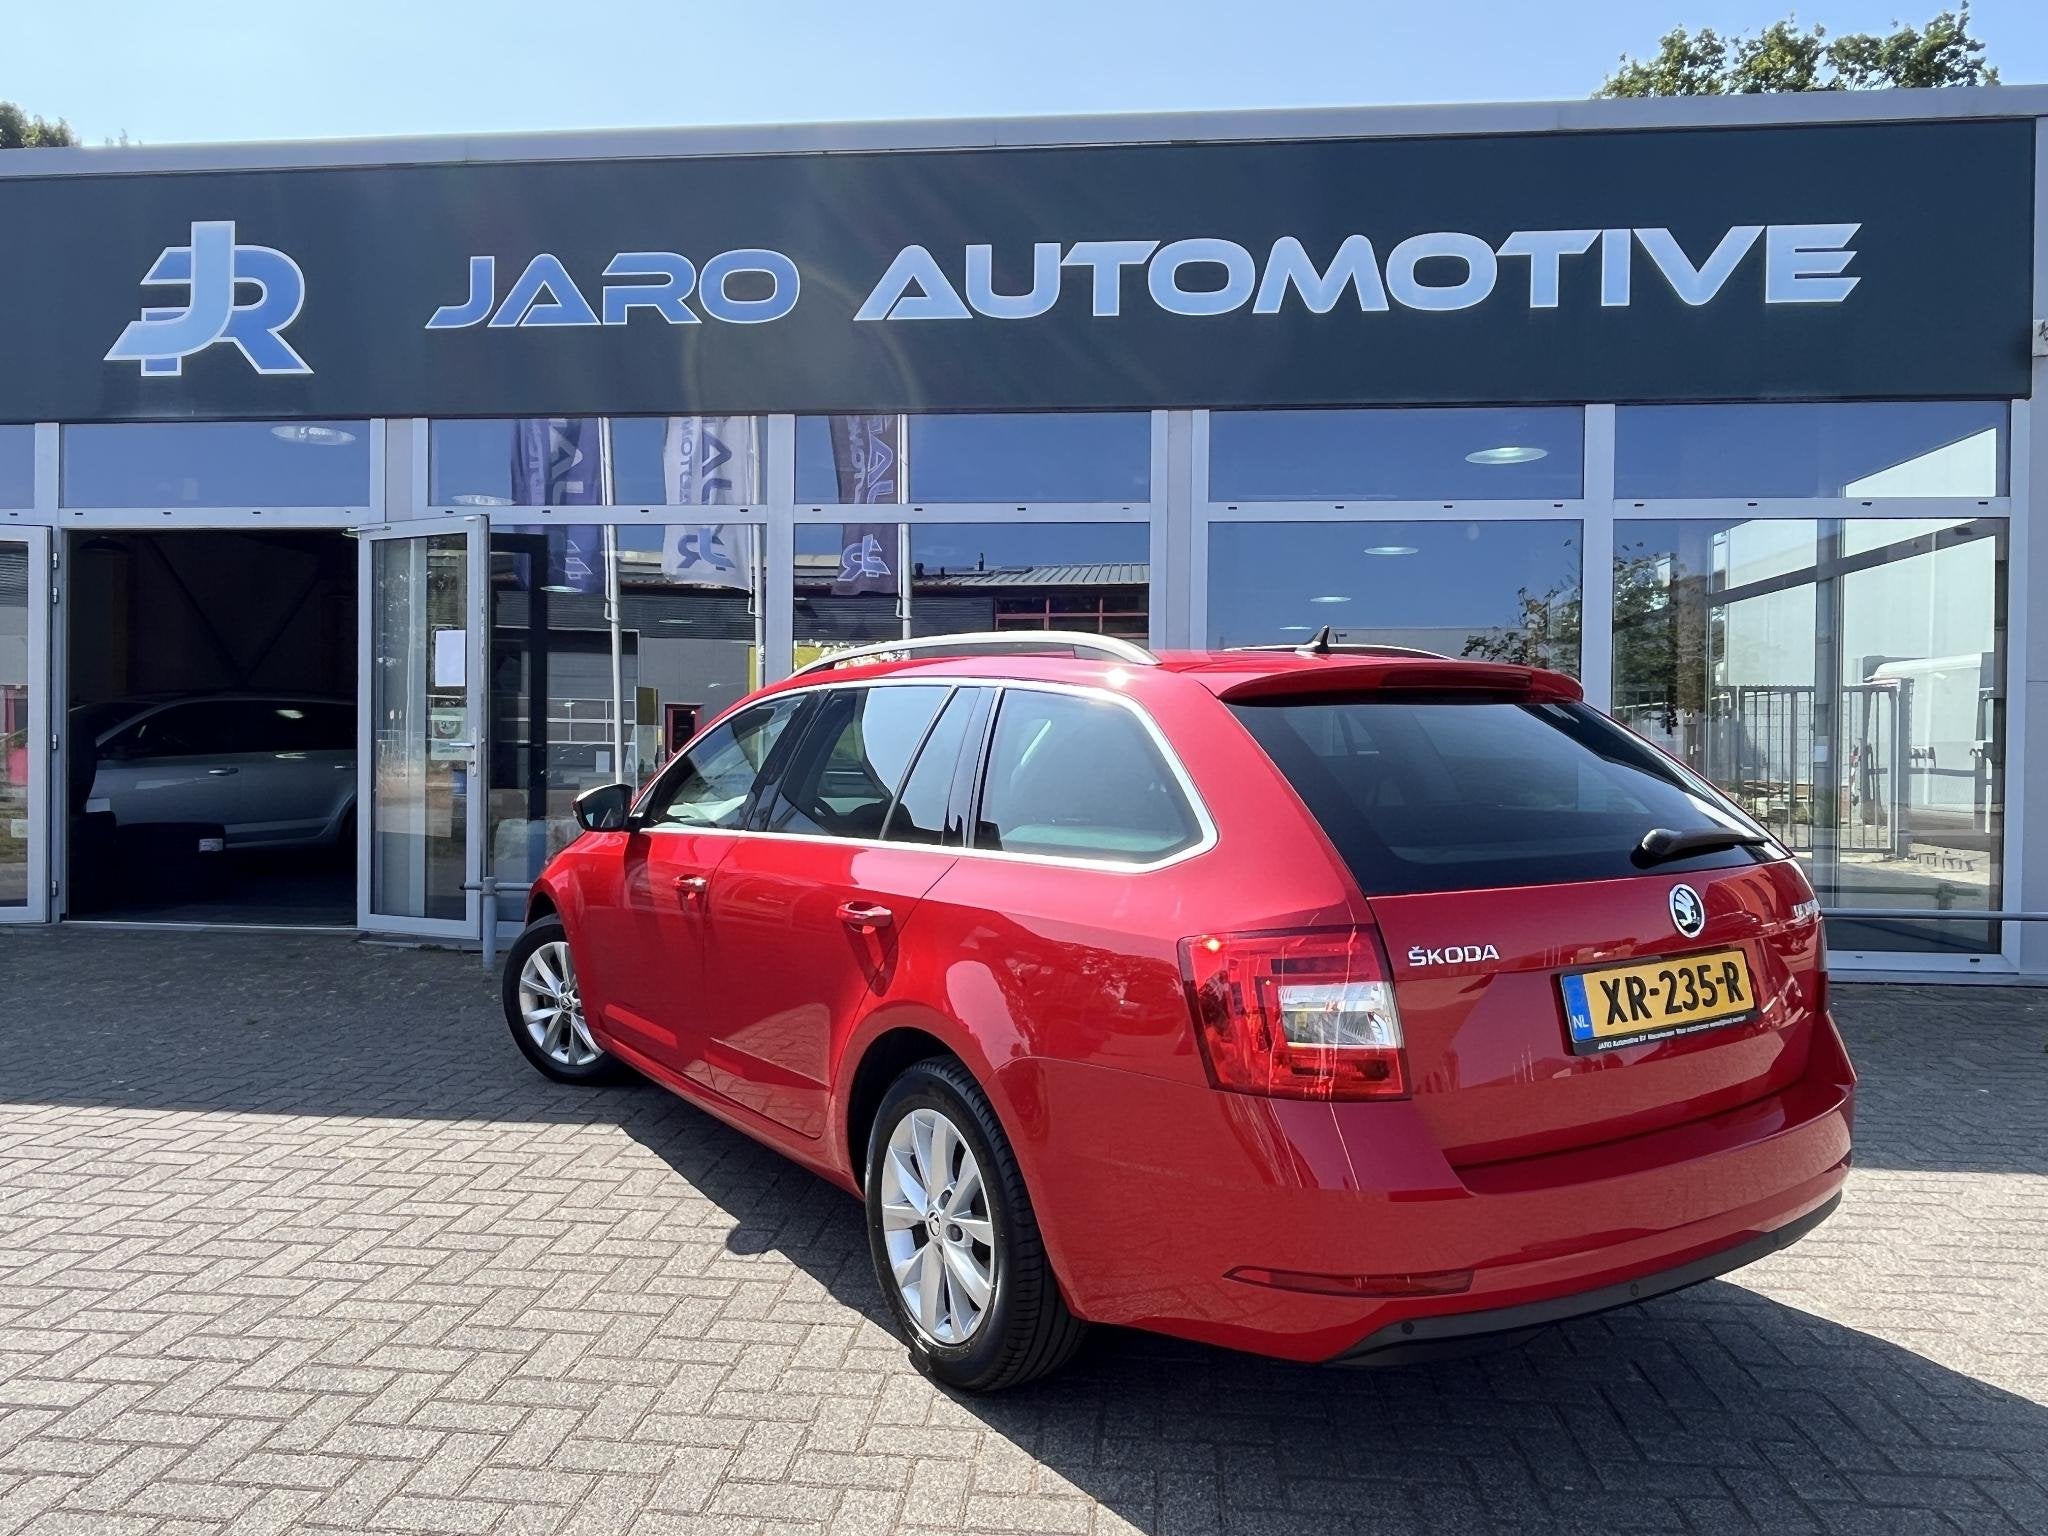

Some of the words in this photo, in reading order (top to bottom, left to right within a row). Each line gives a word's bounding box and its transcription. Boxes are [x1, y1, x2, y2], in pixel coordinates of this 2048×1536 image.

[425, 247, 801, 328] JARO
[853, 222, 1863, 321] AUTOMOTIVE
[1408, 945, 1500, 967] ŠKODA
[1600, 961, 1744, 1025] XR-235-R
[1572, 1015, 1589, 1029] NL
